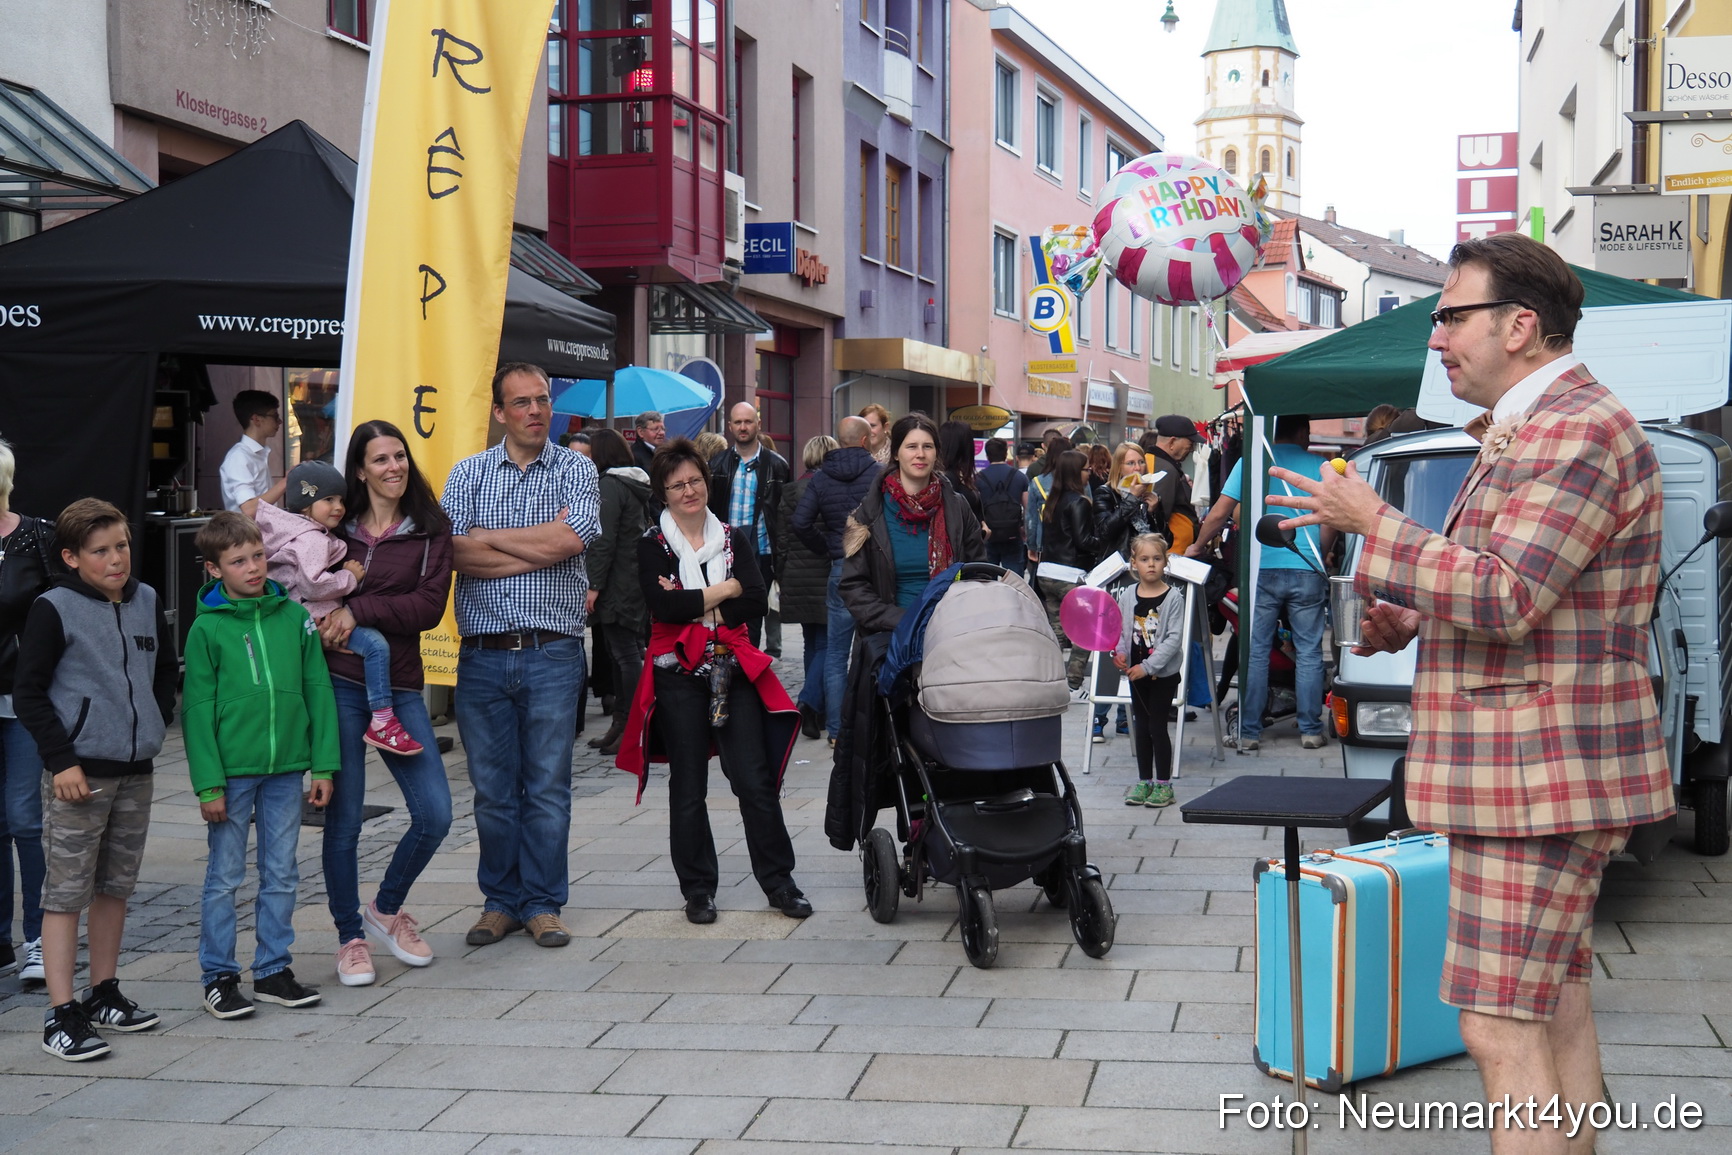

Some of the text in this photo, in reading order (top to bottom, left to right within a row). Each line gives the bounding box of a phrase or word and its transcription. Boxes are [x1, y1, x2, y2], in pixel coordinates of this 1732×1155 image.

[1668, 93, 1729, 102] SCHÖNE WÄSCHE
[176, 89, 268, 134] Klostergasse 2
[1139, 175, 1220, 208] HAPPY
[1671, 176, 1705, 187] Endlich
[1600, 220, 1683, 242] SARAH K
[1600, 242, 1683, 252] MODE & LIFESTYLE
[1033, 296, 1056, 320] B
[547, 338, 610, 361] www.creppresso.de
[425, 633, 450, 643] auch
